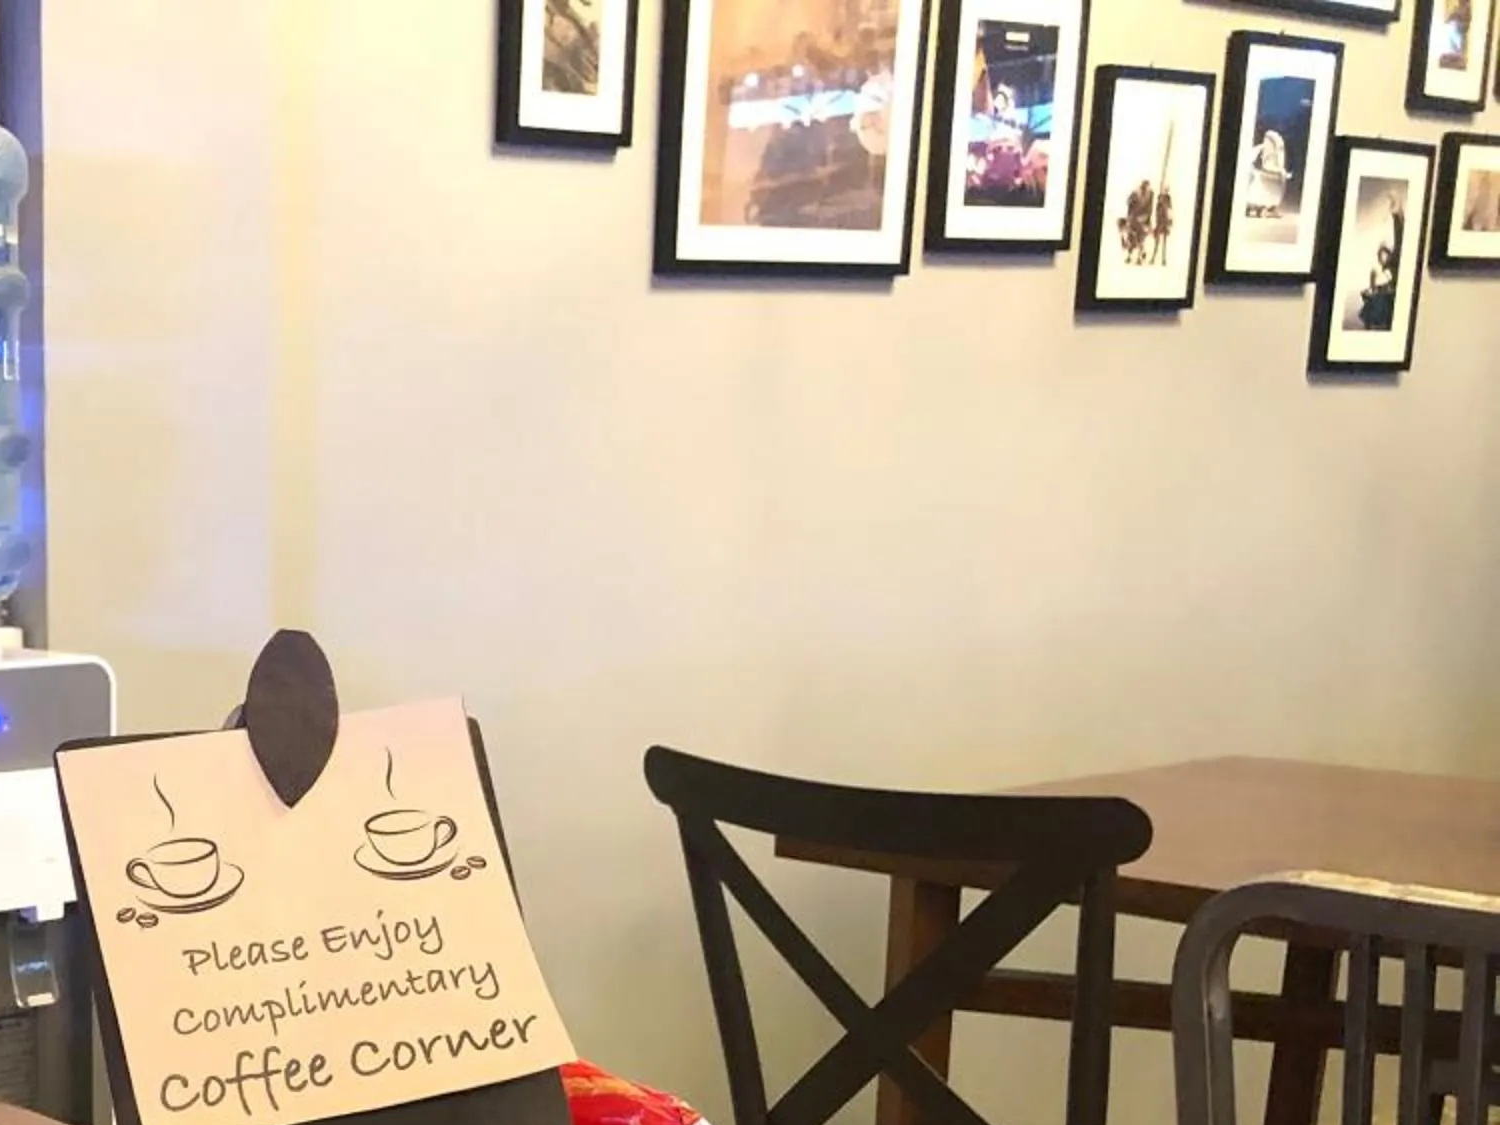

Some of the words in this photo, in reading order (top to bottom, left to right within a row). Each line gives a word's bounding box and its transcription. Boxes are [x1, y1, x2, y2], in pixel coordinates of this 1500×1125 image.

[182, 934, 309, 976] Please
[321, 909, 444, 961] Enjoy
[173, 961, 500, 1036] Complimentary
[159, 1046, 334, 1117] Coffee
[350, 1013, 538, 1077] Corner
